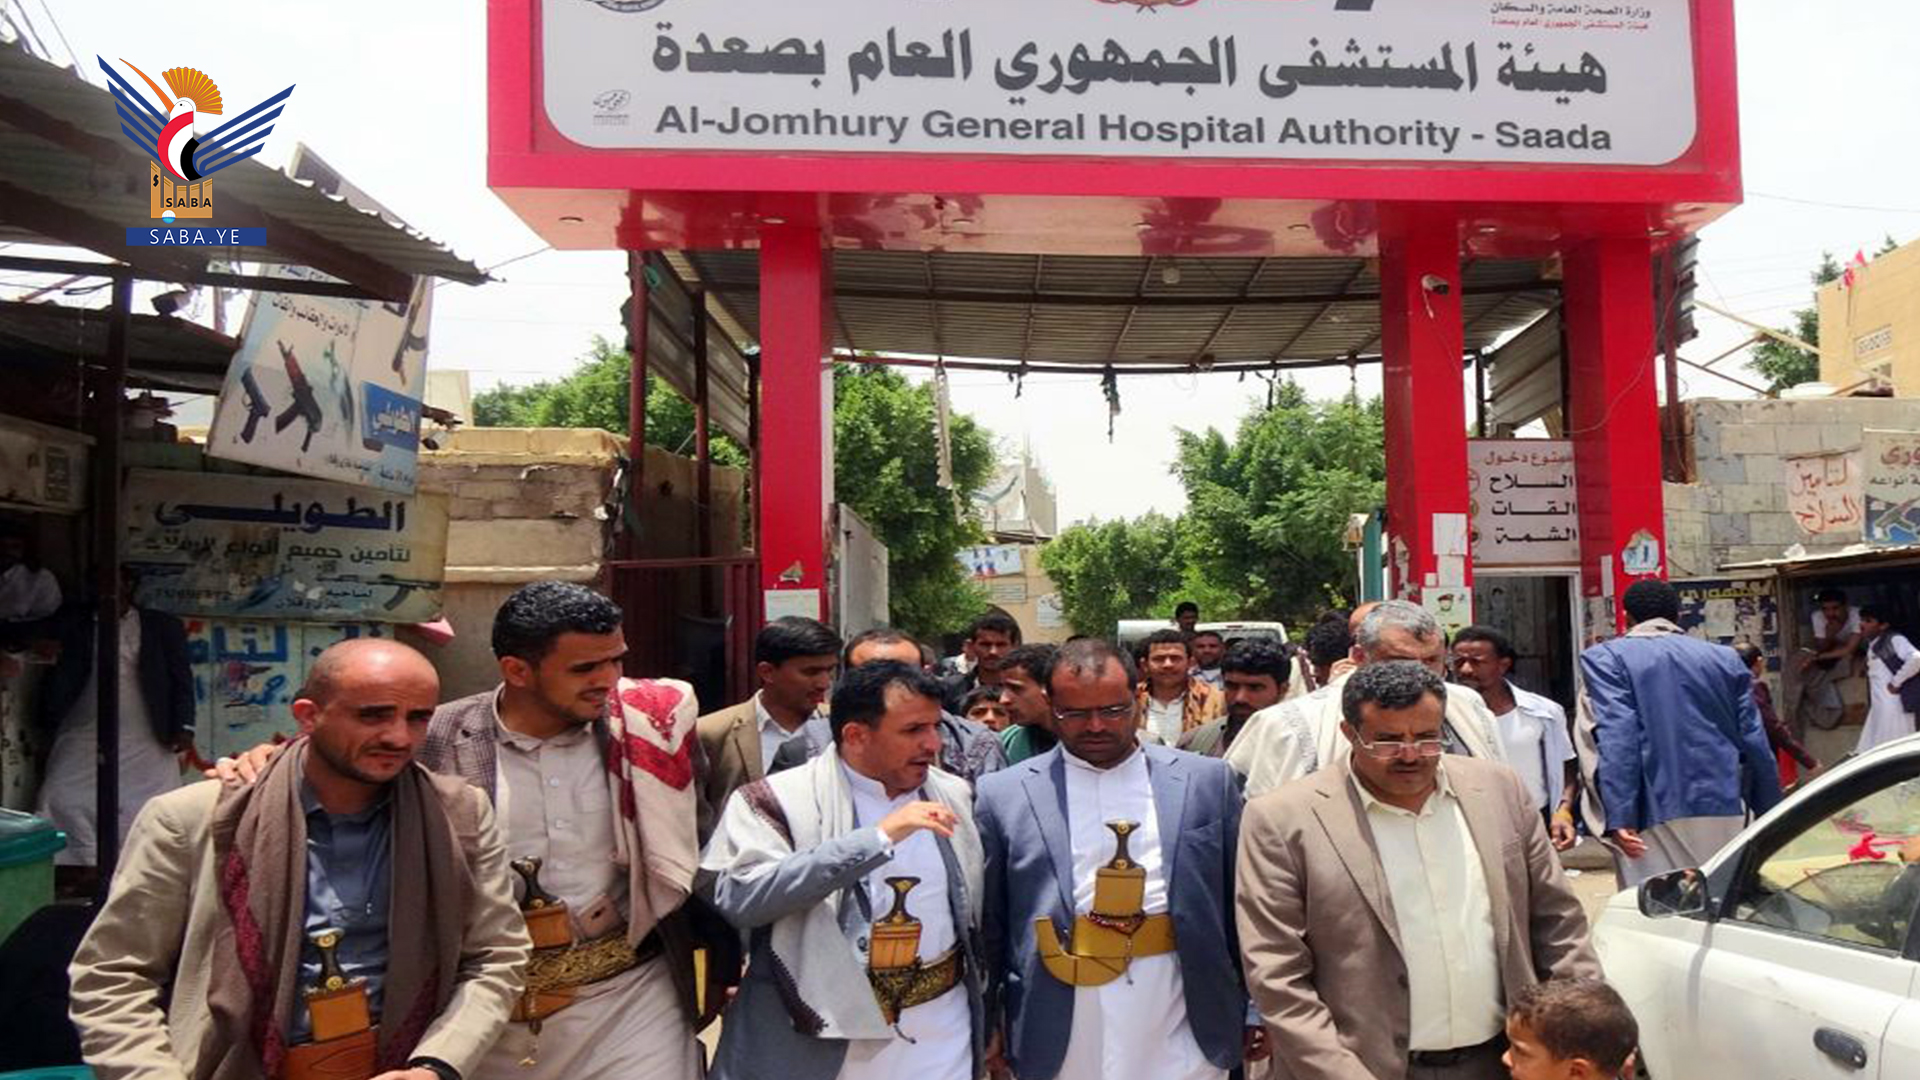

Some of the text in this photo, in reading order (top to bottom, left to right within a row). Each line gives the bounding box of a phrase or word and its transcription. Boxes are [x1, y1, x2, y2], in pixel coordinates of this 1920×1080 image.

[653, 21, 1606, 105] هيئة المستشفى الجمهوري العام بصعدة
[655, 106, 908, 144] Al-Jomhury
[921, 110, 1085, 140] General
[1099, 113, 1264, 149] Hospital
[1278, 117, 1460, 153] Authority
[1495, 121, 1611, 150] Saada
[1531, 451, 1573, 467] منوع
[1490, 473, 1574, 494] السلاح
[1492, 501, 1576, 515] القات
[1494, 526, 1577, 544] الشمة
